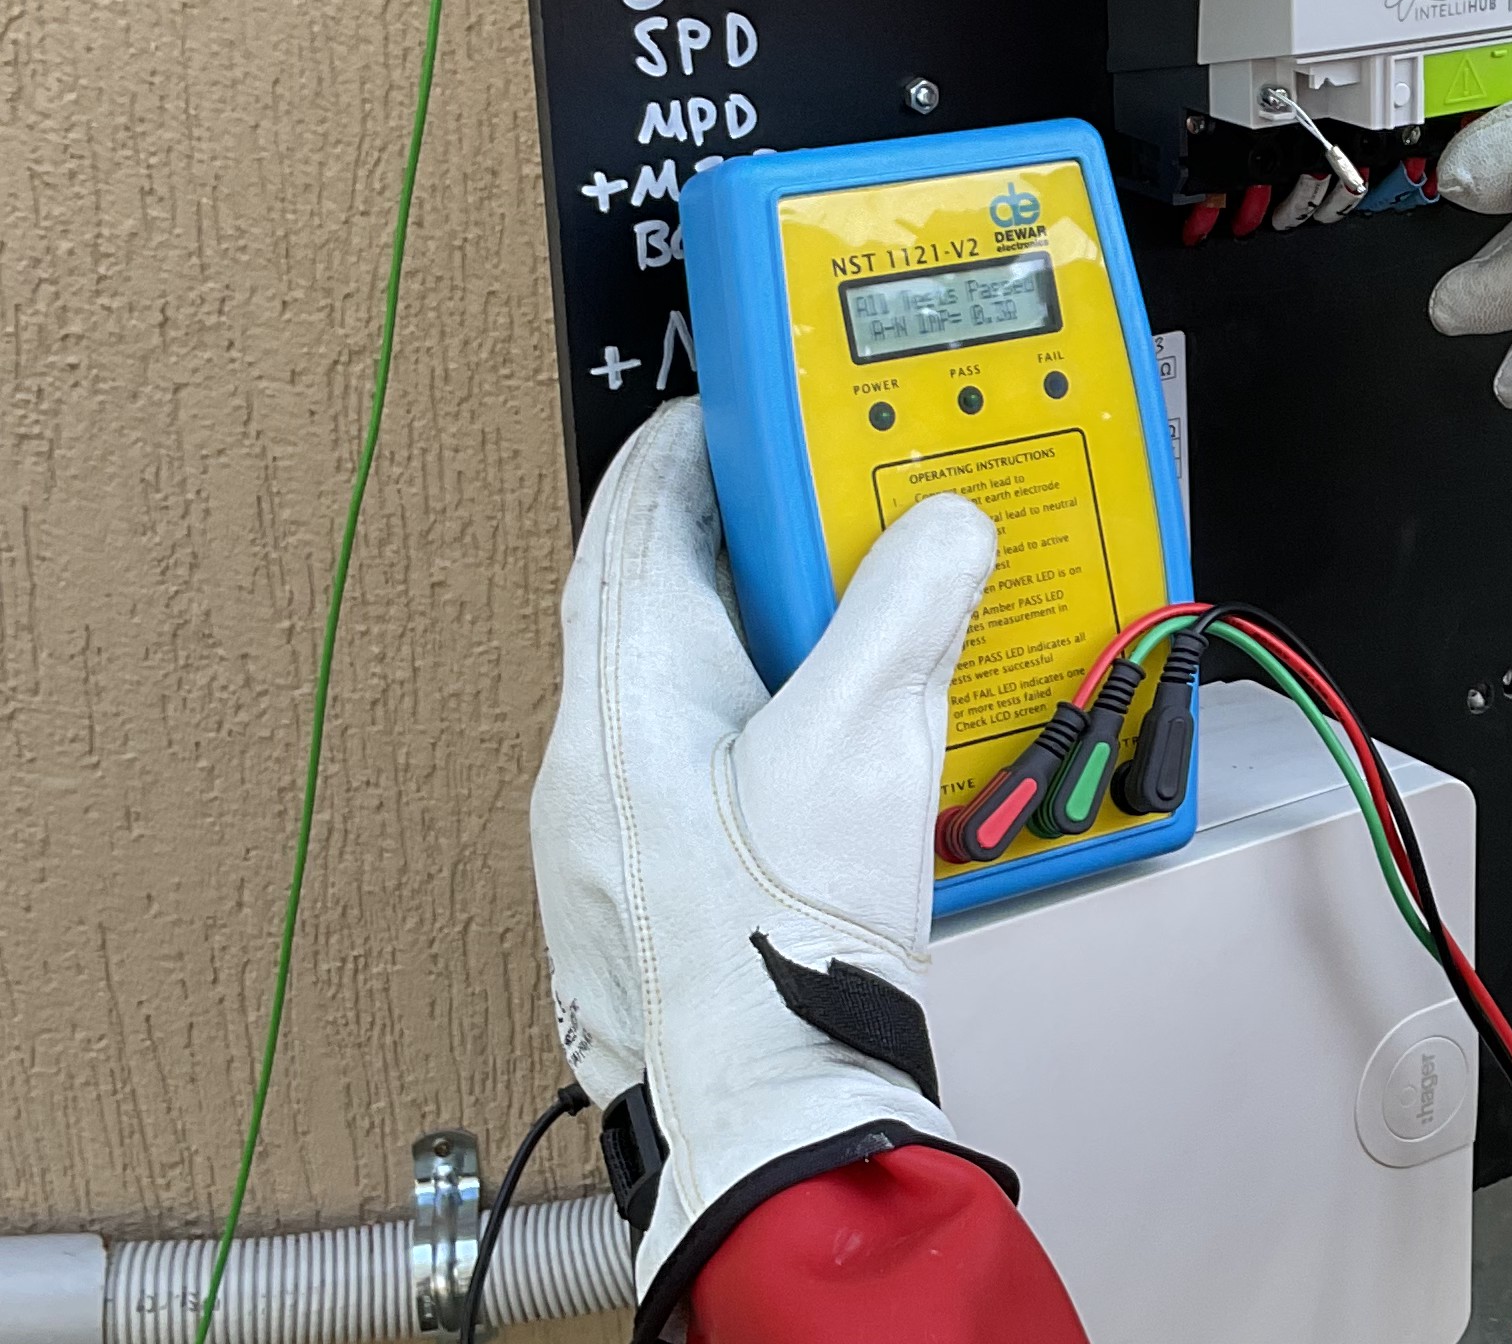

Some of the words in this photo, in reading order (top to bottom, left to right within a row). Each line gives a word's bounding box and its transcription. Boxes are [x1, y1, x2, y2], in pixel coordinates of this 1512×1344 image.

[634, 11, 759, 78] SPD
[638, 93, 758, 147] MPD
[994, 225, 1047, 244] DEWAR
[996, 238, 1049, 253] electronics
[832, 254, 876, 278] NST
[886, 238, 980, 269] 1121-V2
[854, 292, 890, 318] All
[965, 277, 1036, 302] Passed
[950, 364, 982, 378] PASS
[1037, 351, 1065, 364] FAIL
[852, 379, 900, 396] POWER
[909, 463, 974, 485] OPERATING
[976, 447, 1056, 472] INSTRUCTIONS
[961, 482, 988, 495] earth
[989, 476, 1012, 489] lead
[1014, 474, 1025, 484] to
[985, 490, 1012, 505] earth
[1014, 480, 1061, 498] electrode
[1005, 508, 1027, 520] lead
[1030, 505, 1041, 516] to
[1043, 497, 1078, 513] neutral
[1004, 543, 1025, 556] lead
[1027, 540, 1038, 550] to
[1041, 534, 1070, 548] active
[998, 574, 1034, 591] POWER
[1036, 570, 1055, 583] LED
[1058, 567, 1067, 578] is
[1069, 565, 1082, 576] on
[982, 602, 1016, 620] Amber
[1018, 594, 1043, 609] PASS
[1045, 590, 1064, 604] LED
[988, 606, 1057, 629] measurement
[1059, 603, 1069, 614] in
[978, 652, 1004, 667] PASS
[1006, 646, 1025, 660] LED
[1027, 637, 1072, 656] indicates
[1074, 632, 1086, 644] all
[975, 667, 1000, 681] were
[1002, 653, 1054, 675] successful
[951, 691, 971, 706] Red
[973, 686, 995, 701] FAIL
[998, 681, 1018, 695] LED
[1020, 671, 1065, 690] indicates
[1066, 666, 1086, 679] one
[953, 709, 965, 720] or
[968, 702, 995, 717] more
[997, 695, 1021, 710] tests
[1024, 687, 1053, 704] failed
[955, 716, 988, 734] Check
[990, 710, 1012, 725] LCD
[1014, 702, 1048, 719] screen
